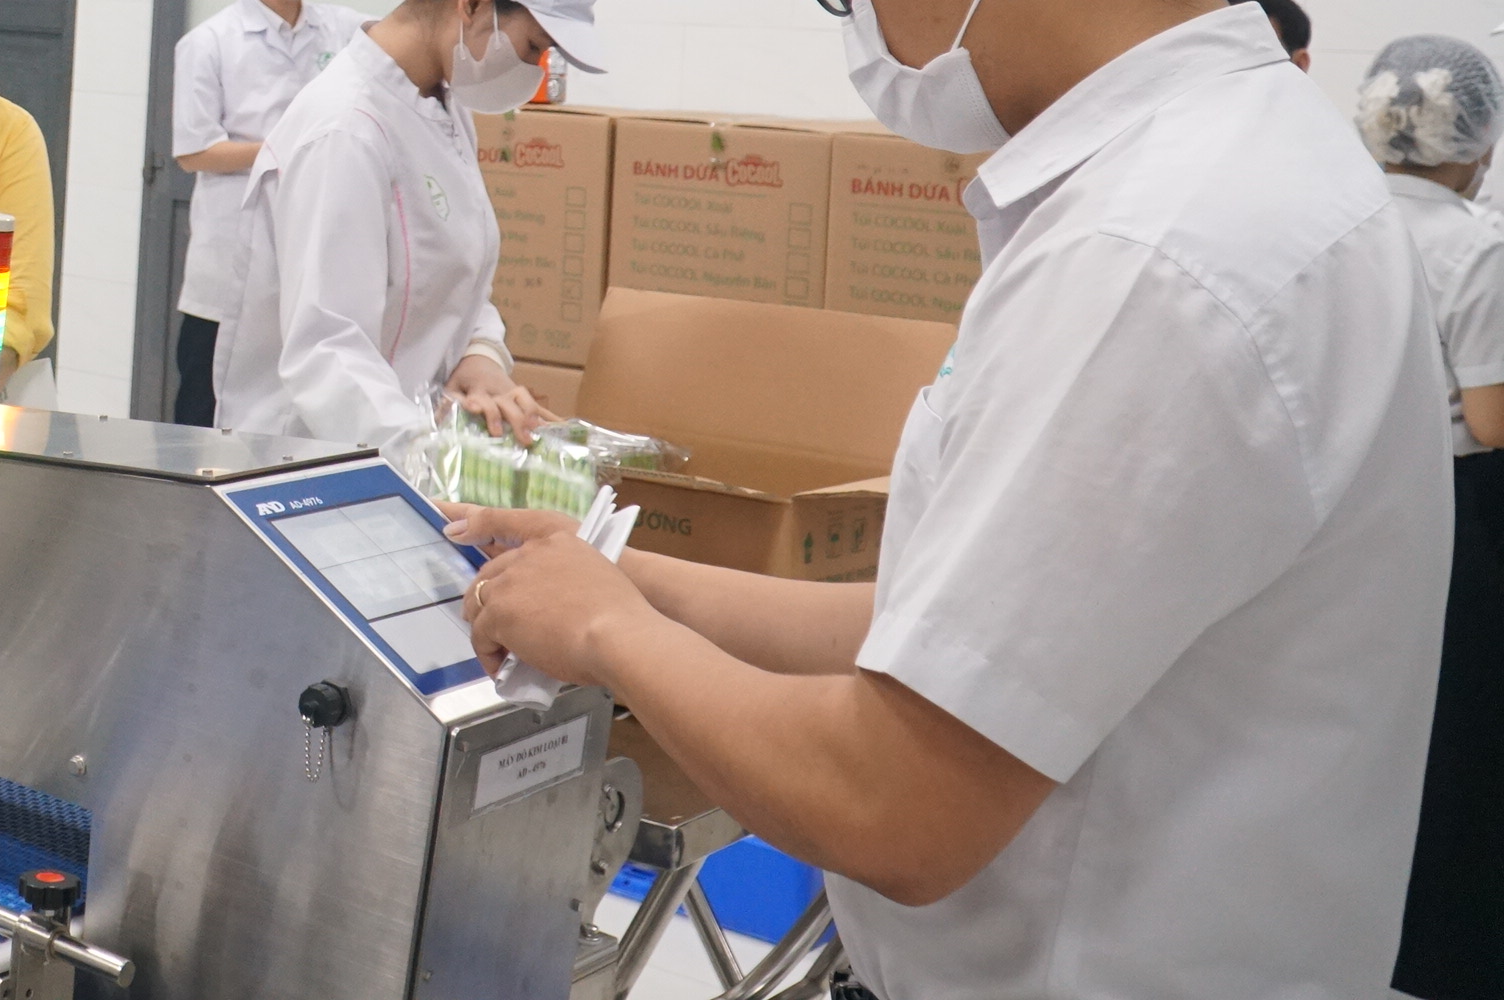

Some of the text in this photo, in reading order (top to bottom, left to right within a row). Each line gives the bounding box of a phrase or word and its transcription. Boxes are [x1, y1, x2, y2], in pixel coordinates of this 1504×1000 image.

[633, 159, 678, 178] BÁNH
[851, 177, 903, 196] BÁNH
[289, 496, 324, 510] AD-4976
[528, 744, 543, 758] KIM
